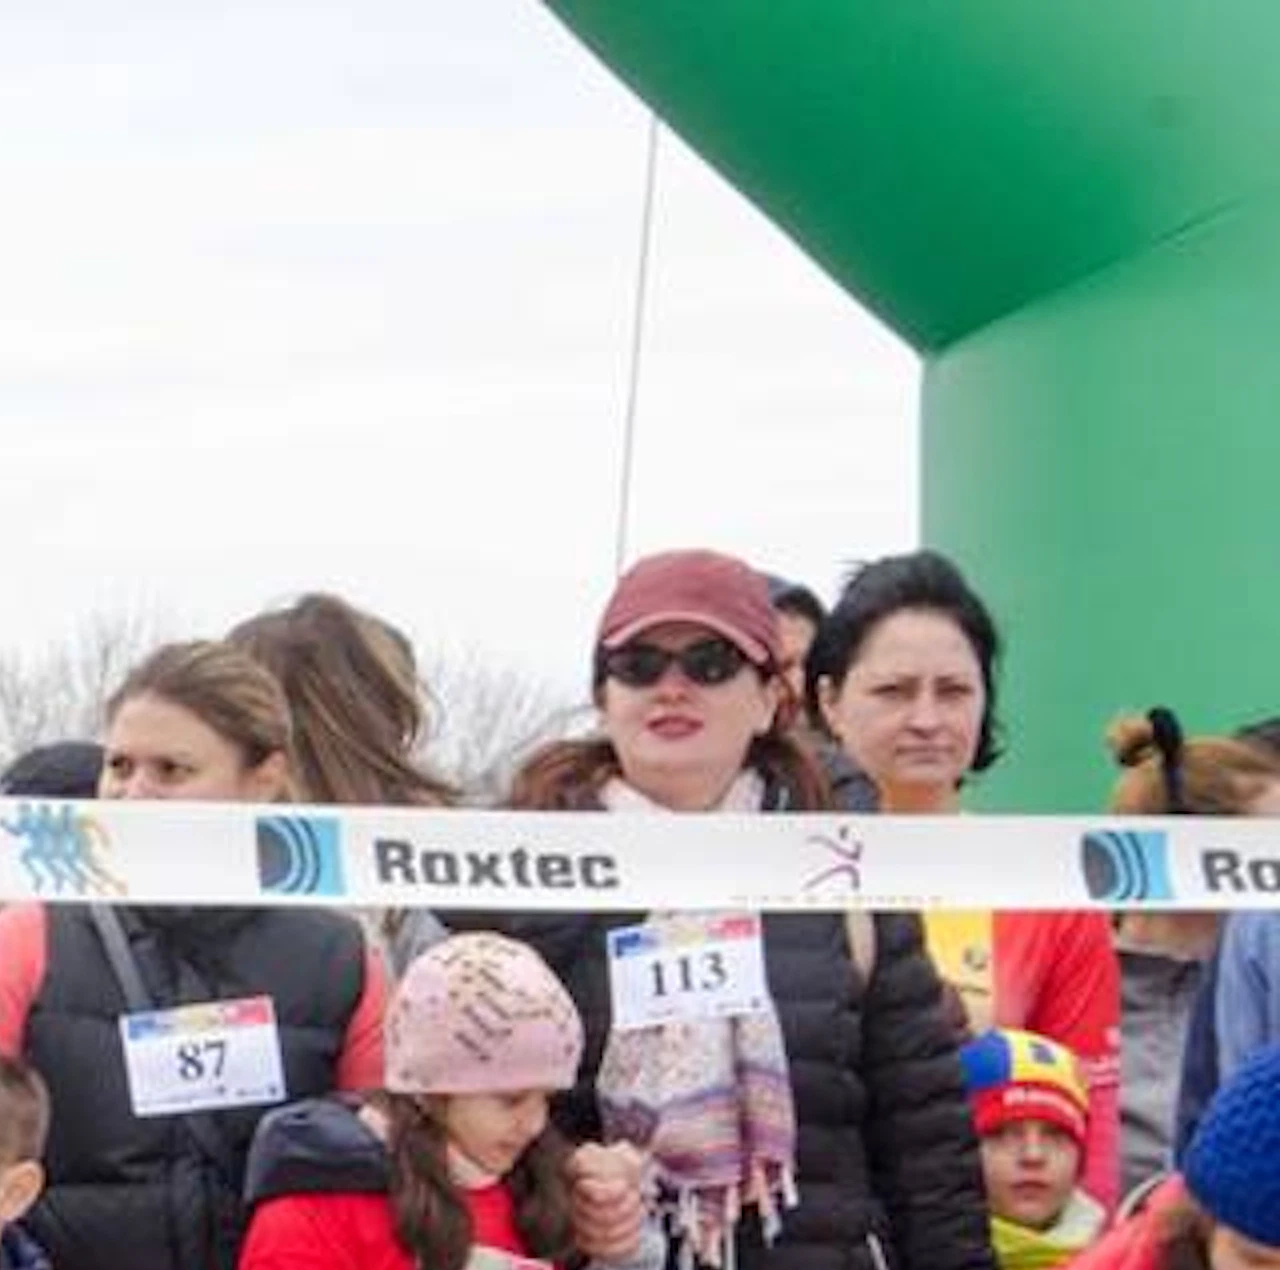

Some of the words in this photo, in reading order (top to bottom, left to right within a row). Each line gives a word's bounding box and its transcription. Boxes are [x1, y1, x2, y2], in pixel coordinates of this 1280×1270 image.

[374, 837, 619, 888] Roxtec
[652, 951, 728, 996] 113
[178, 1040, 225, 1080] 87
